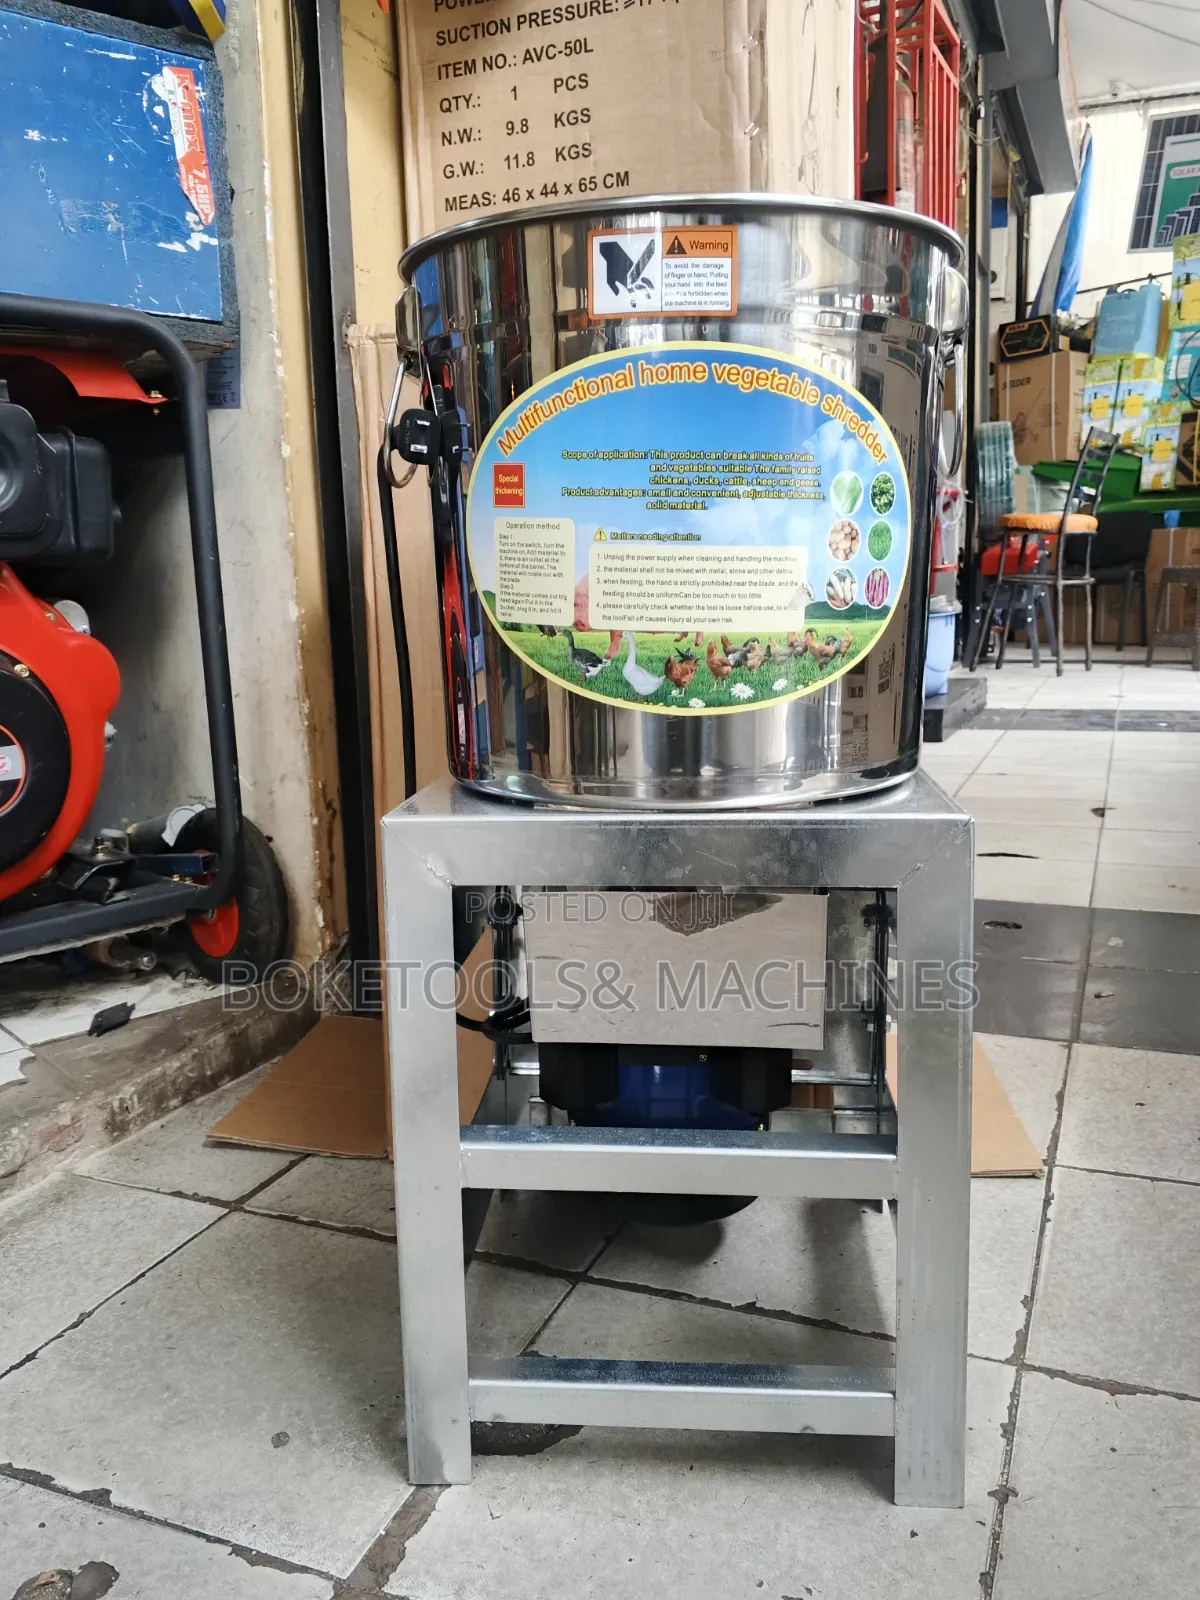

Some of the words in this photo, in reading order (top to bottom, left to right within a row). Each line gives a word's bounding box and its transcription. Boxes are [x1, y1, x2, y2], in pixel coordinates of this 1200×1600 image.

[436, 17, 511, 46] SUCTION
[517, 0, 619, 31] PRESSURE:
[437, 59, 477, 80] ITEM
[482, 53, 517, 72] NO.:
[522, 38, 594, 65] AVC-50L
[440, 93, 481, 113] QTY.:
[510, 85, 518, 101] 1
[553, 73, 589, 94] PCS
[441, 127, 482, 146] N.W.:
[505, 118, 529, 136] 9.8
[554, 107, 591, 128] KGS
[443, 160, 484, 179] G.W.:
[504, 151, 535, 170] 11.8
[555, 142, 592, 162] KGS
[444, 191, 497, 212] MEAS:
[502, 187, 521, 204] 46
[526, 188, 535, 201] x
[540, 181, 559, 198] 44
[564, 182, 573, 195] x
[578, 176, 598, 193] 65
[603, 170, 630, 189] CM
[689, 240, 729, 253] Warning
[702, 262, 724, 270] damage
[671, 271, 686, 280] finger
[710, 271, 729, 280] Putting
[665, 282, 676, 290] your
[497, 362, 634, 457] Multifunctional
[638, 361, 709, 386] home
[712, 362, 821, 407] vegetable
[820, 394, 889, 466] shredder
[562, 449, 587, 461] Scope
[588, 449, 597, 460] of
[598, 449, 648, 461] application:
[650, 449, 668, 460] This
[670, 449, 704, 461] product
[705, 451, 721, 460] can
[723, 450, 748, 461] break
[749, 451, 760, 461] all
[761, 451, 784, 461] kinds
[784, 451, 794, 462] of
[794, 452, 815, 463] fruits
[649, 463, 667, 472] and
[668, 463, 717, 474] vegetables
[718, 464, 753, 473] suitable
[754, 464, 770, 474] The
[771, 465, 797, 476] family
[797, 465, 821, 475] raised
[498, 474, 520, 484] Special
[649, 475, 692, 486] chickens,
[693, 476, 723, 486] ducks,
[723, 477, 750, 487] cattle,
[751, 478, 778, 488] sheep
[779, 478, 795, 487] and
[495, 486, 523, 497] thickening
[562, 487, 593, 497] Product
[594, 487, 647, 499] advantages:
[647, 488, 671, 498] small
[672, 488, 690, 498] and
[690, 488, 742, 499] convenient,
[742, 489, 786, 500] adjustable
[787, 491, 826, 501] thickness,
[646, 500, 668, 510] solid
[669, 500, 708, 510] material.
[505, 521, 535, 530] Operation
[536, 522, 560, 530] method
[610, 532, 638, 541] Matters
[638, 532, 669, 542] needing
[669, 533, 702, 542] attention
[603, 553, 625, 562] Unplug
[636, 554, 656, 562] power
[656, 554, 677, 563] supply
[696, 555, 722, 563] cleaning
[735, 555, 762, 563] handling
[679, 579, 700, 588] strictly
[701, 580, 733, 588] prohibited
[602, 590, 625, 599] feeding
[625, 590, 646, 598] should
[602, 602, 623, 610] please
[623, 602, 650, 611] carefully
[645, 615, 667, 623] causes
[667, 616, 685, 624] injury
[693, 616, 707, 624] your
